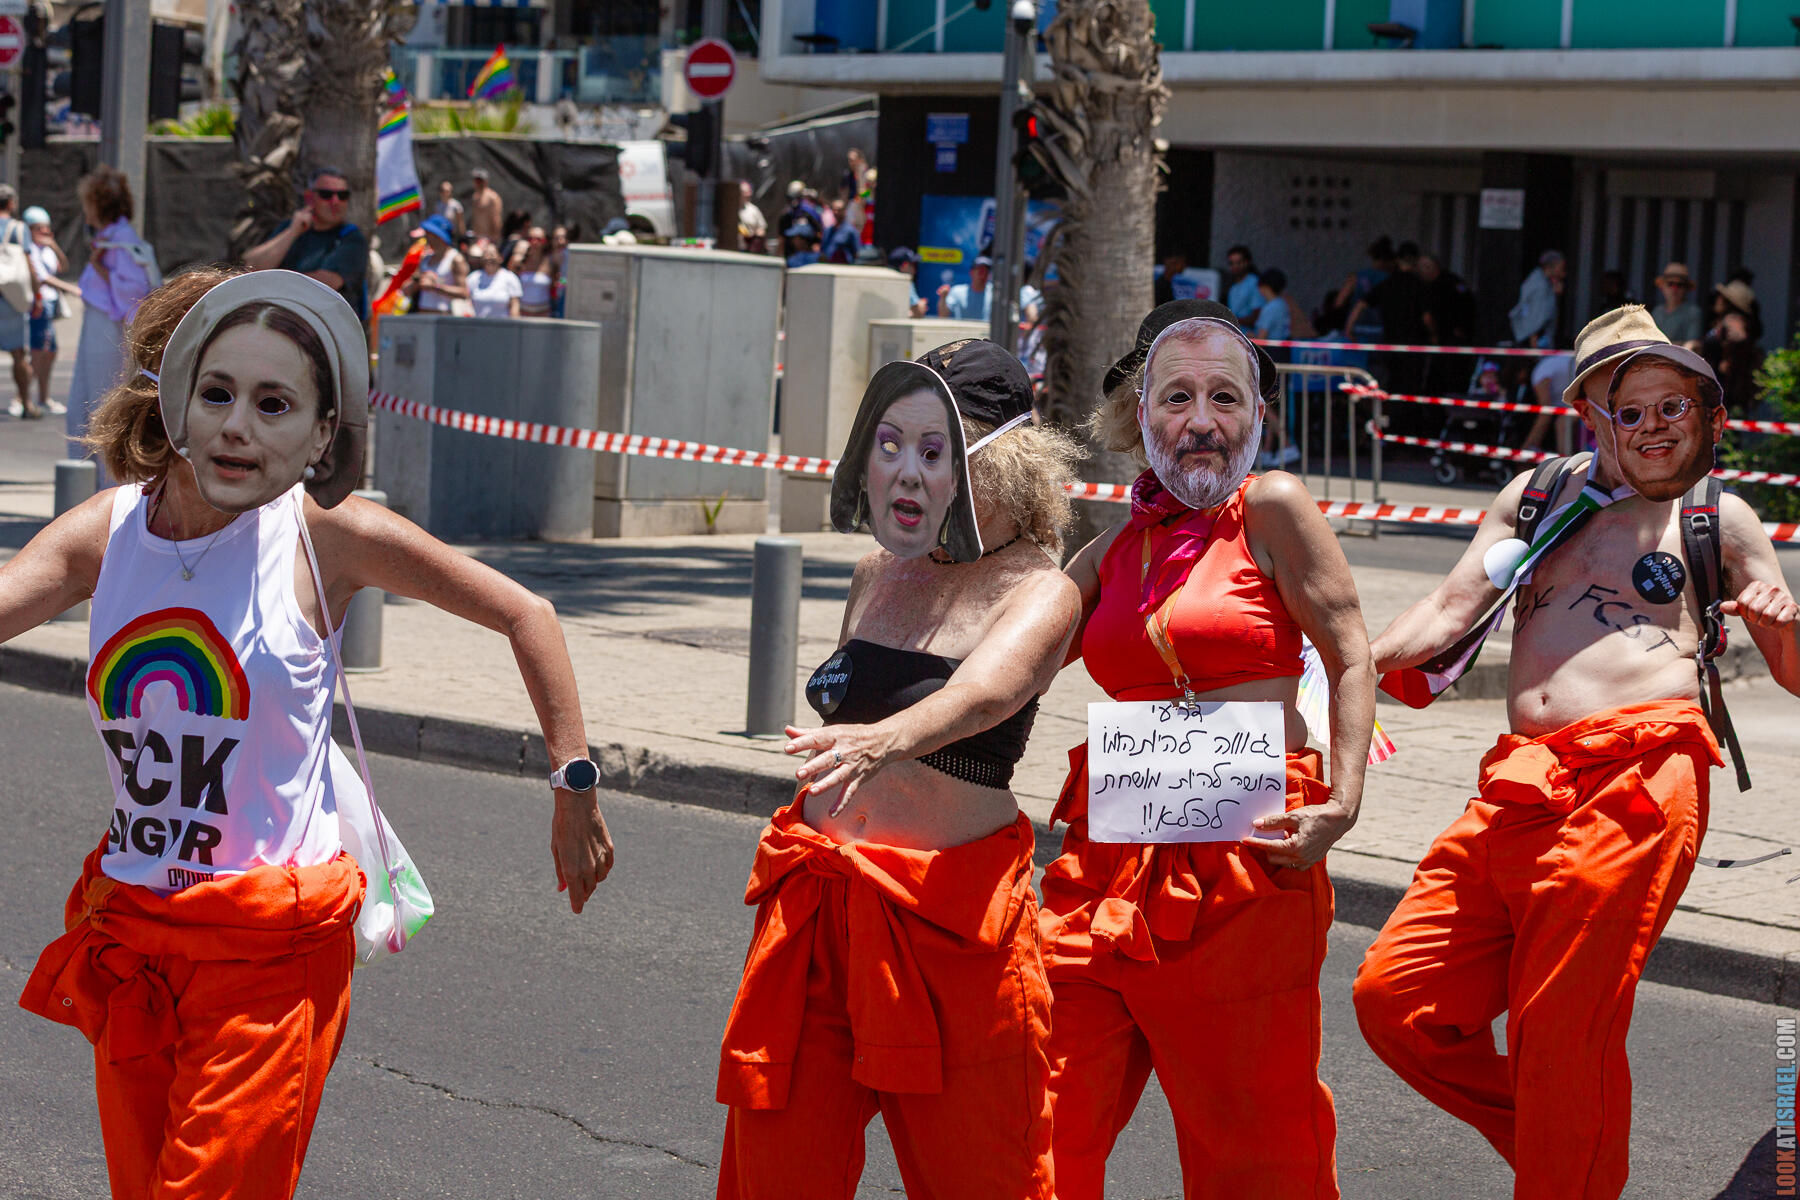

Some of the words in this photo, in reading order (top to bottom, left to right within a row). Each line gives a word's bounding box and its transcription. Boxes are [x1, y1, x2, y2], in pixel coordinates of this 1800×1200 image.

[101, 729, 241, 815] FCK
[1095, 767, 1162, 795] מושחת
[1168, 762, 1232, 790] להיות
